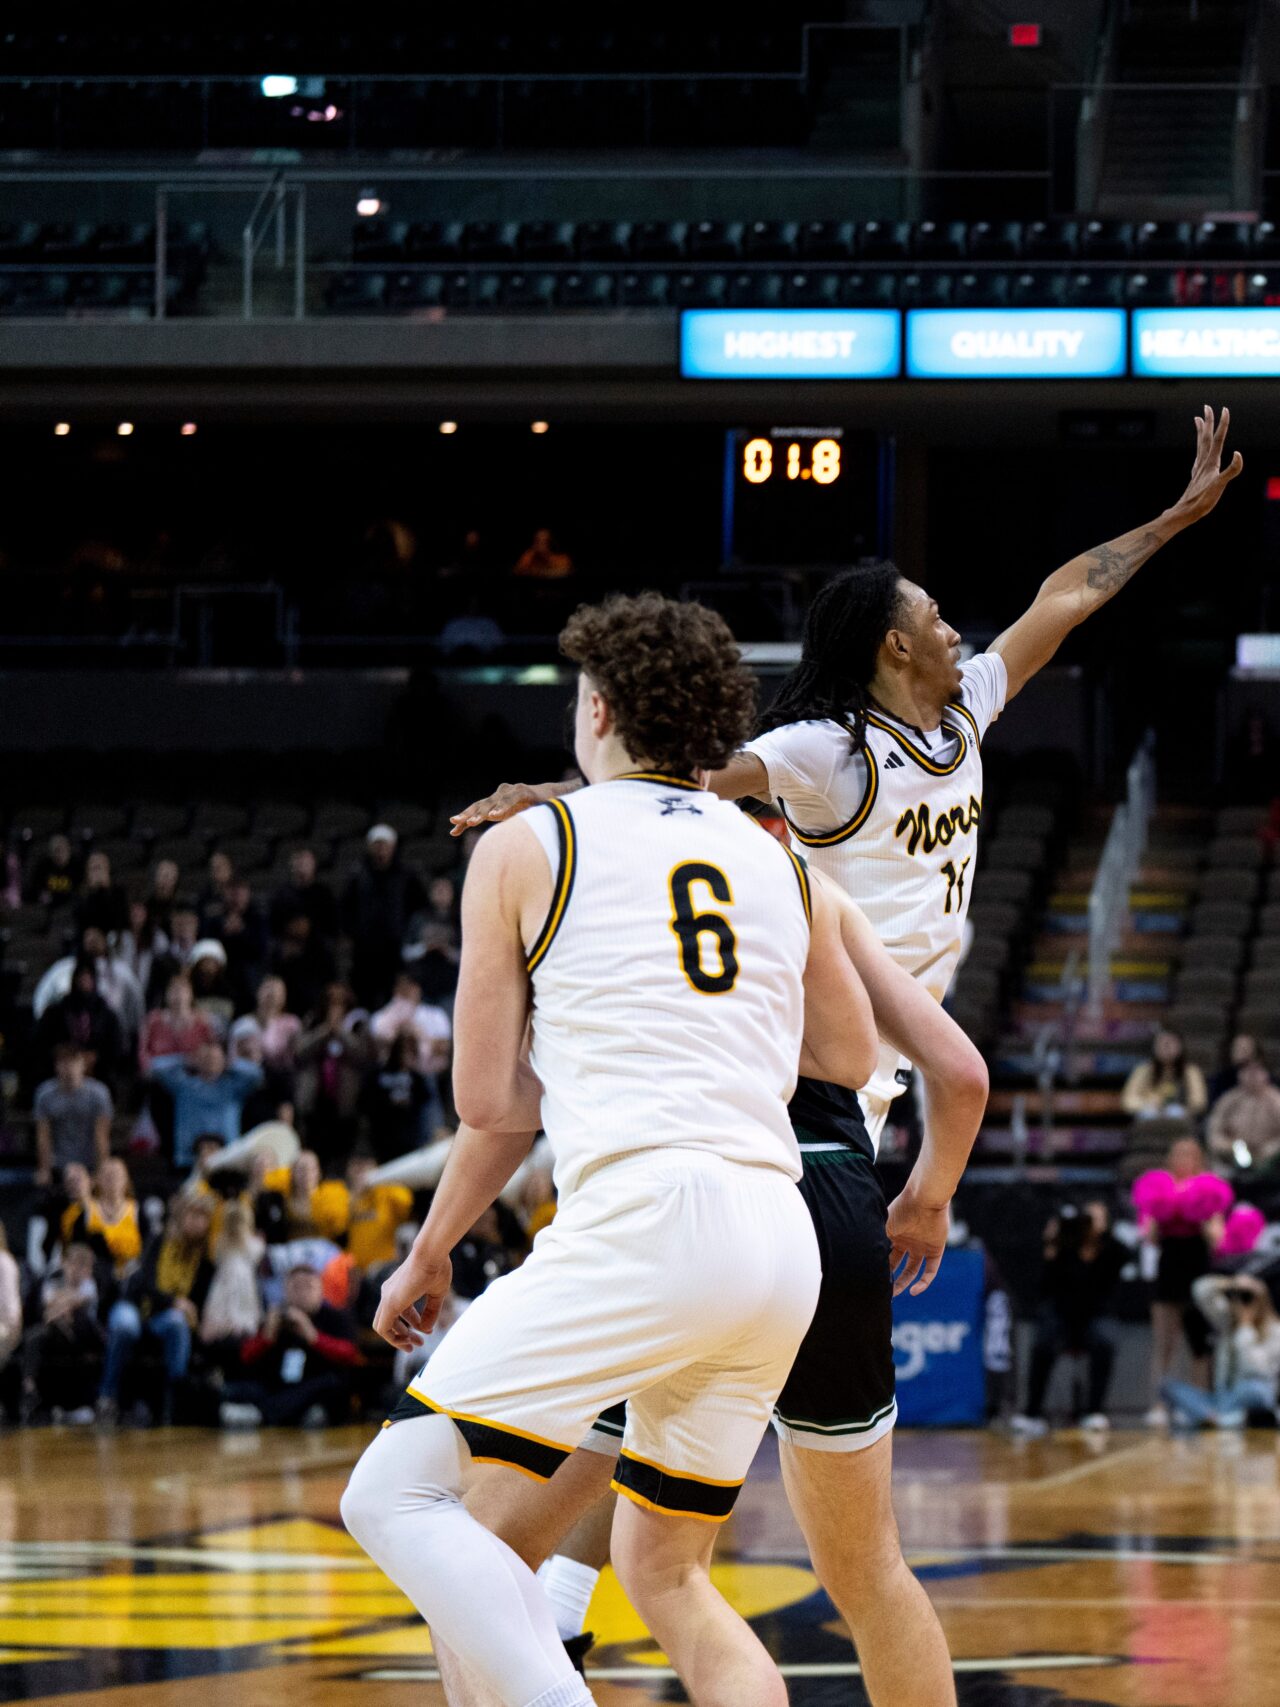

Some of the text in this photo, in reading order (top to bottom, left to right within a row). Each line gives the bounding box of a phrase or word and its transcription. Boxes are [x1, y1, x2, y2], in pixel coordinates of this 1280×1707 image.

[725, 331, 857, 358] HIGHEST
[951, 330, 1084, 358] QUALITY
[895, 794, 981, 857] Nors
[940, 855, 971, 915] 11
[667, 858, 741, 997] 6
[892, 1320, 968, 1381] ger
